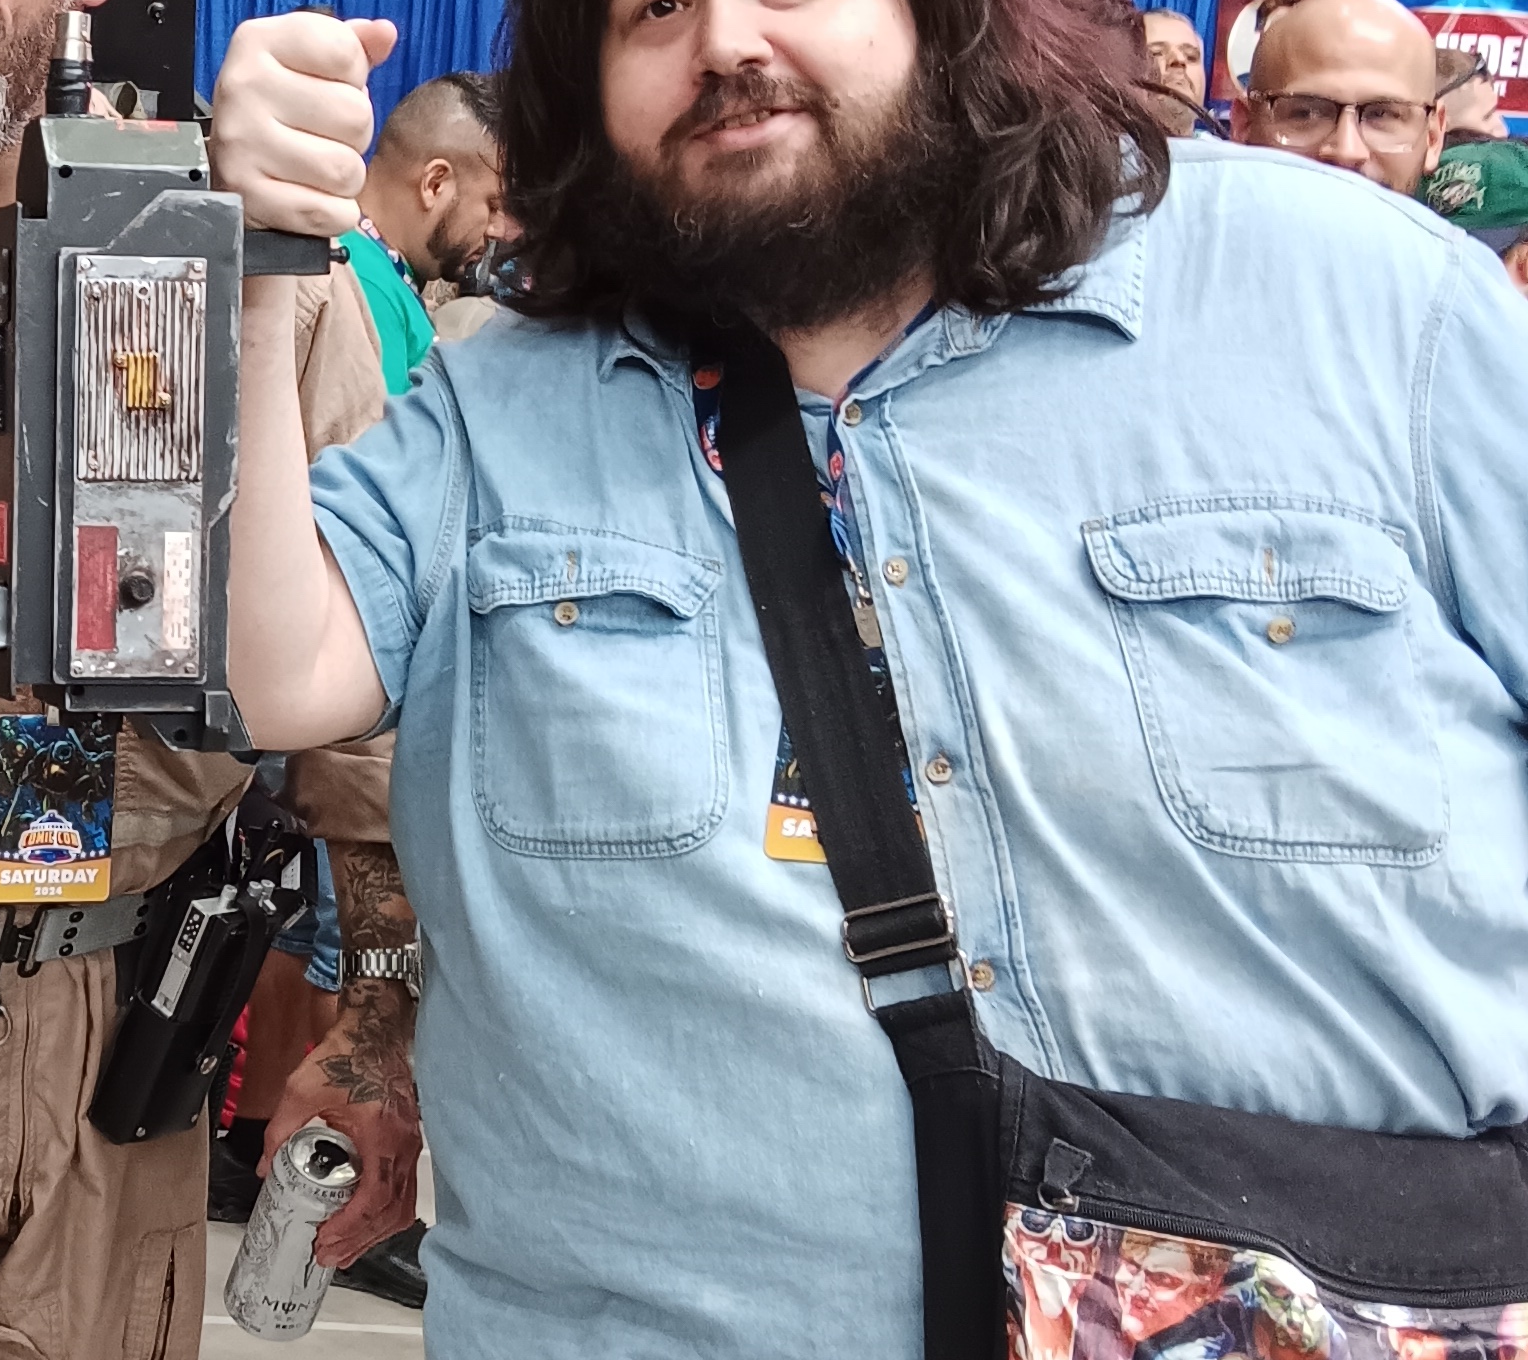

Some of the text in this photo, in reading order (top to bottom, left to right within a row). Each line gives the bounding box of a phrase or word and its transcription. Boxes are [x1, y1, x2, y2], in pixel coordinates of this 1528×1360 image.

[56, 830, 79, 848] CON
[0, 868, 99, 884] SATURDAY
[34, 886, 62, 896] 2024
